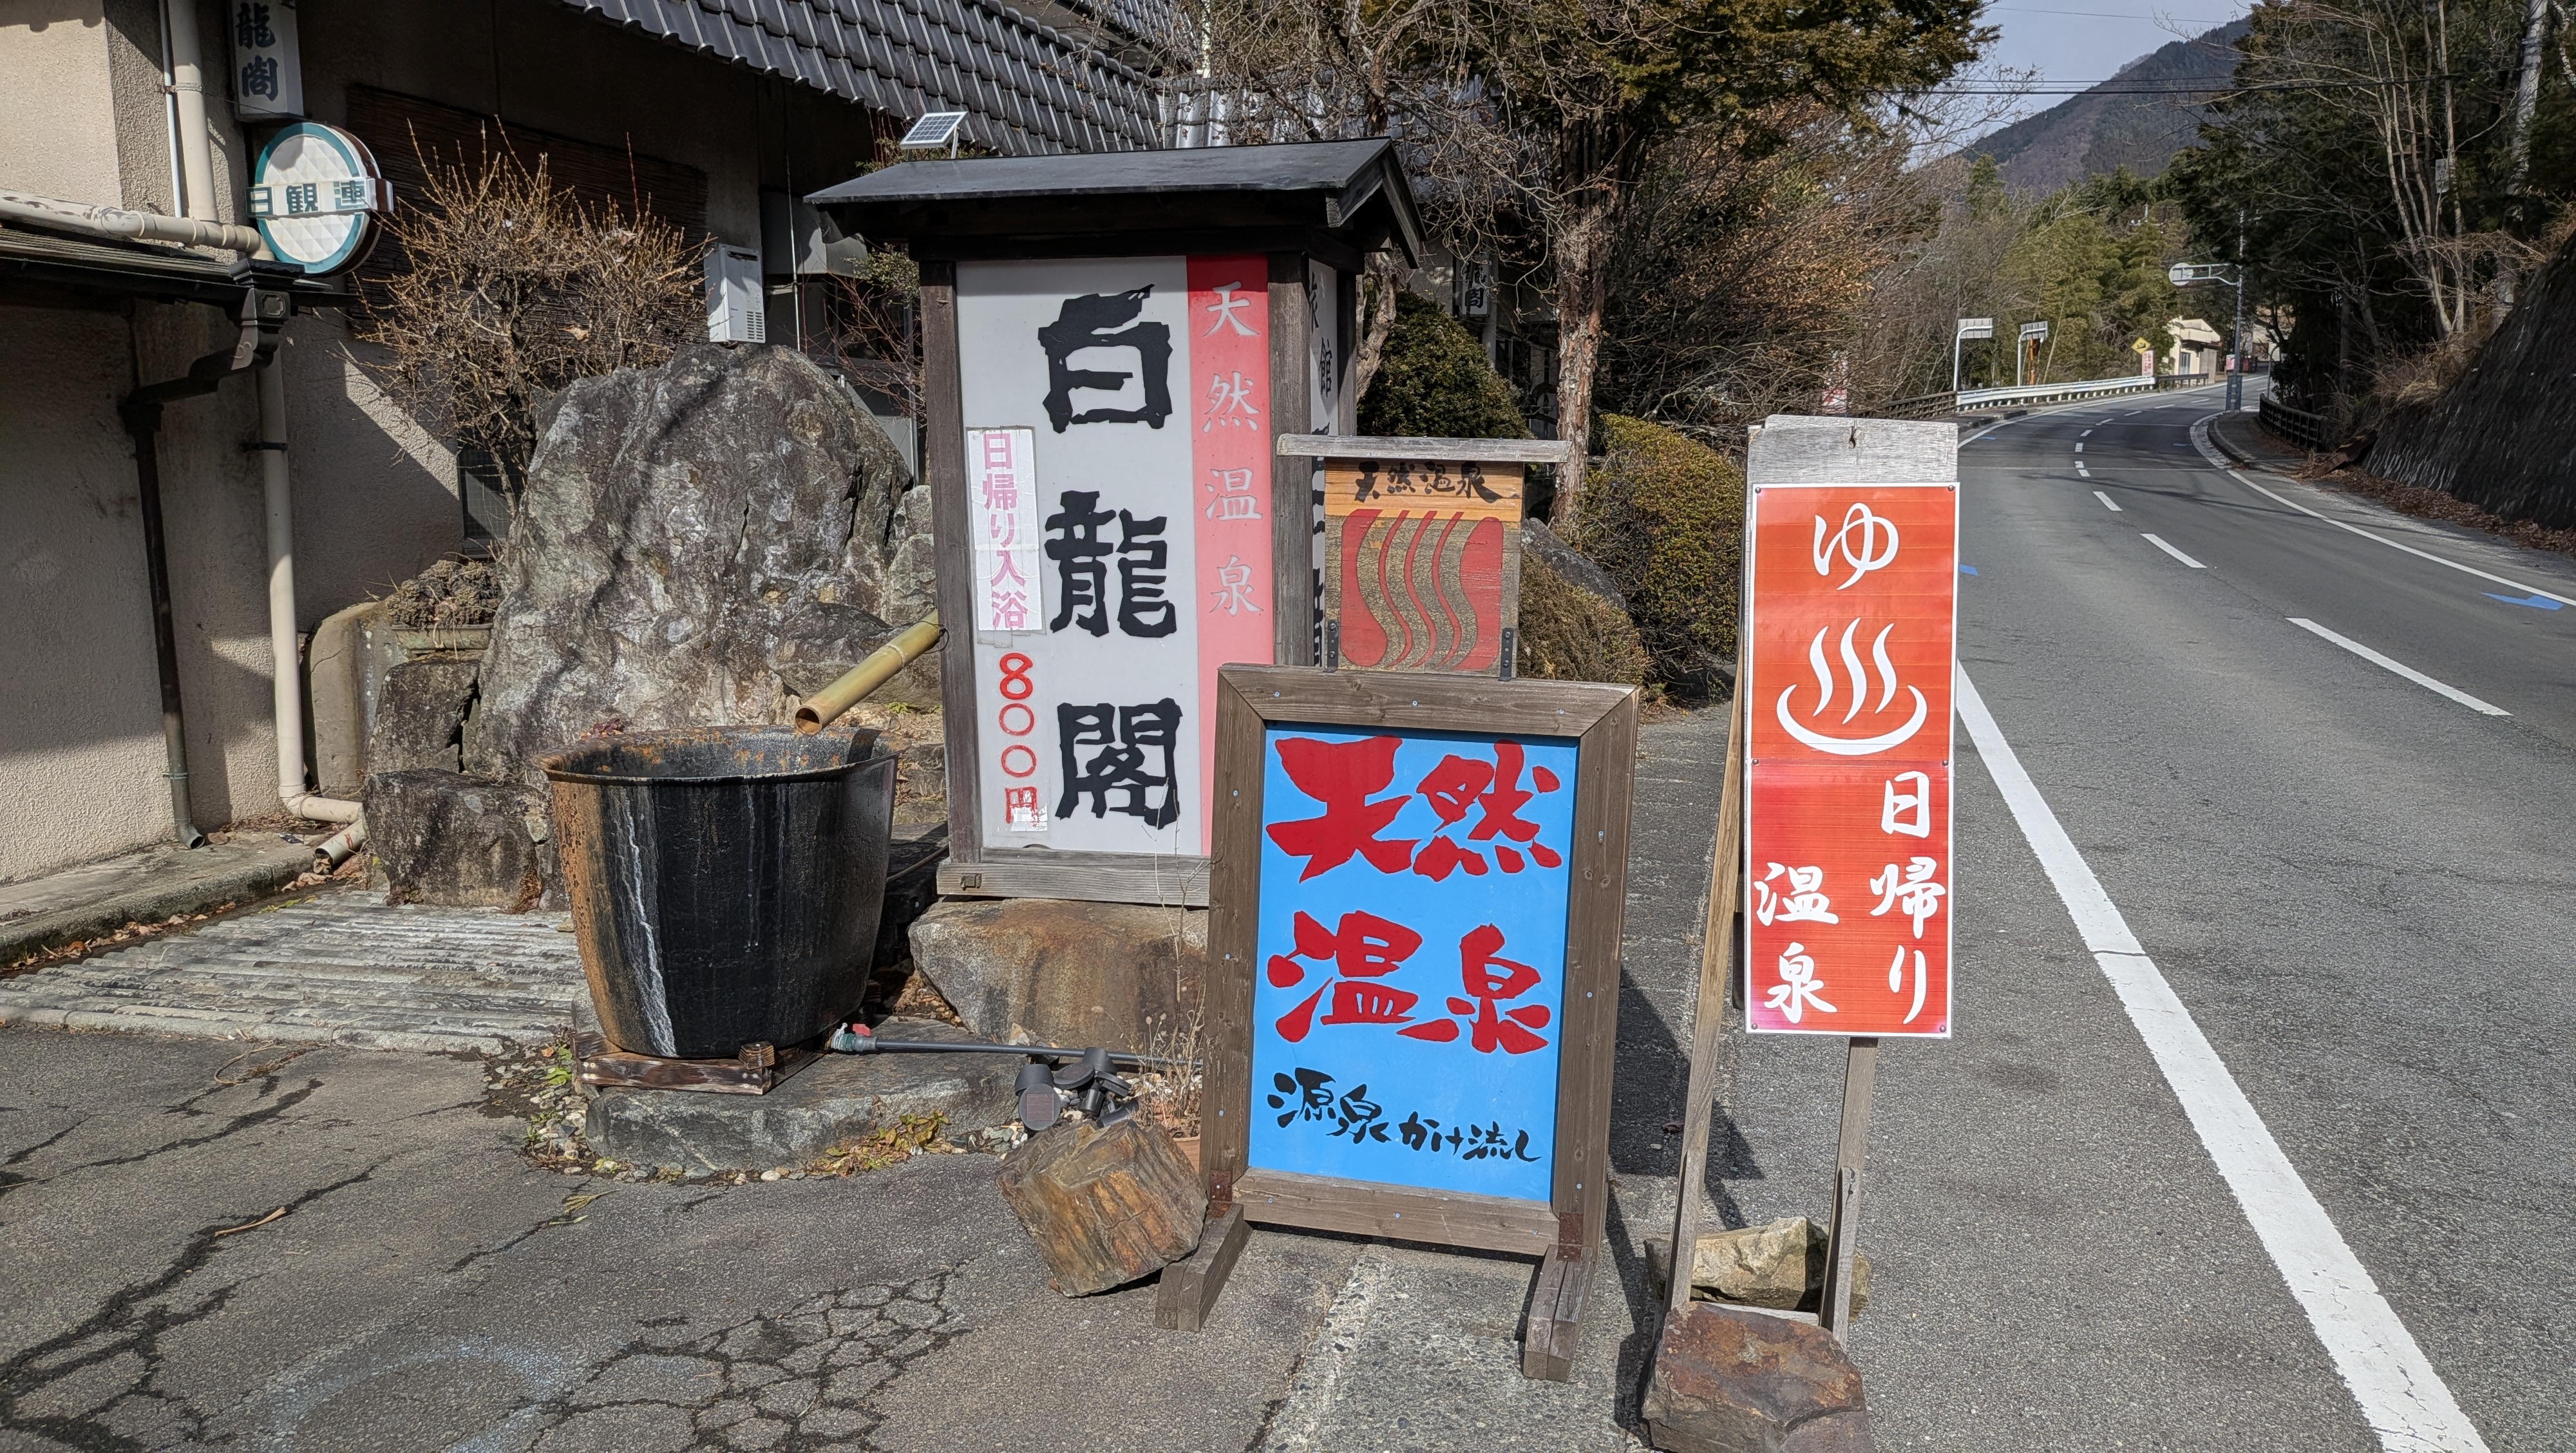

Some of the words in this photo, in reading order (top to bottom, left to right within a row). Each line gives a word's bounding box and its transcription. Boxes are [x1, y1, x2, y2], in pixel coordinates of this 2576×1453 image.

[247, 180, 365, 216] 日観連
[1202, 281, 1264, 616] 天然温泉
[1354, 461, 1504, 503] 天然温泉
[983, 433, 1027, 628] 日帰り入浴
[1037, 283, 1183, 830] 白龍閣
[1813, 502, 1899, 591] ゆ
[1265, 734, 1562, 884] 天然
[1754, 862, 1839, 1023] 温泉
[1870, 771, 1946, 1024] 日帰り
[1267, 910, 1550, 1054] 温泉
[1267, 1067, 1543, 1162] 源泉かけ流し
